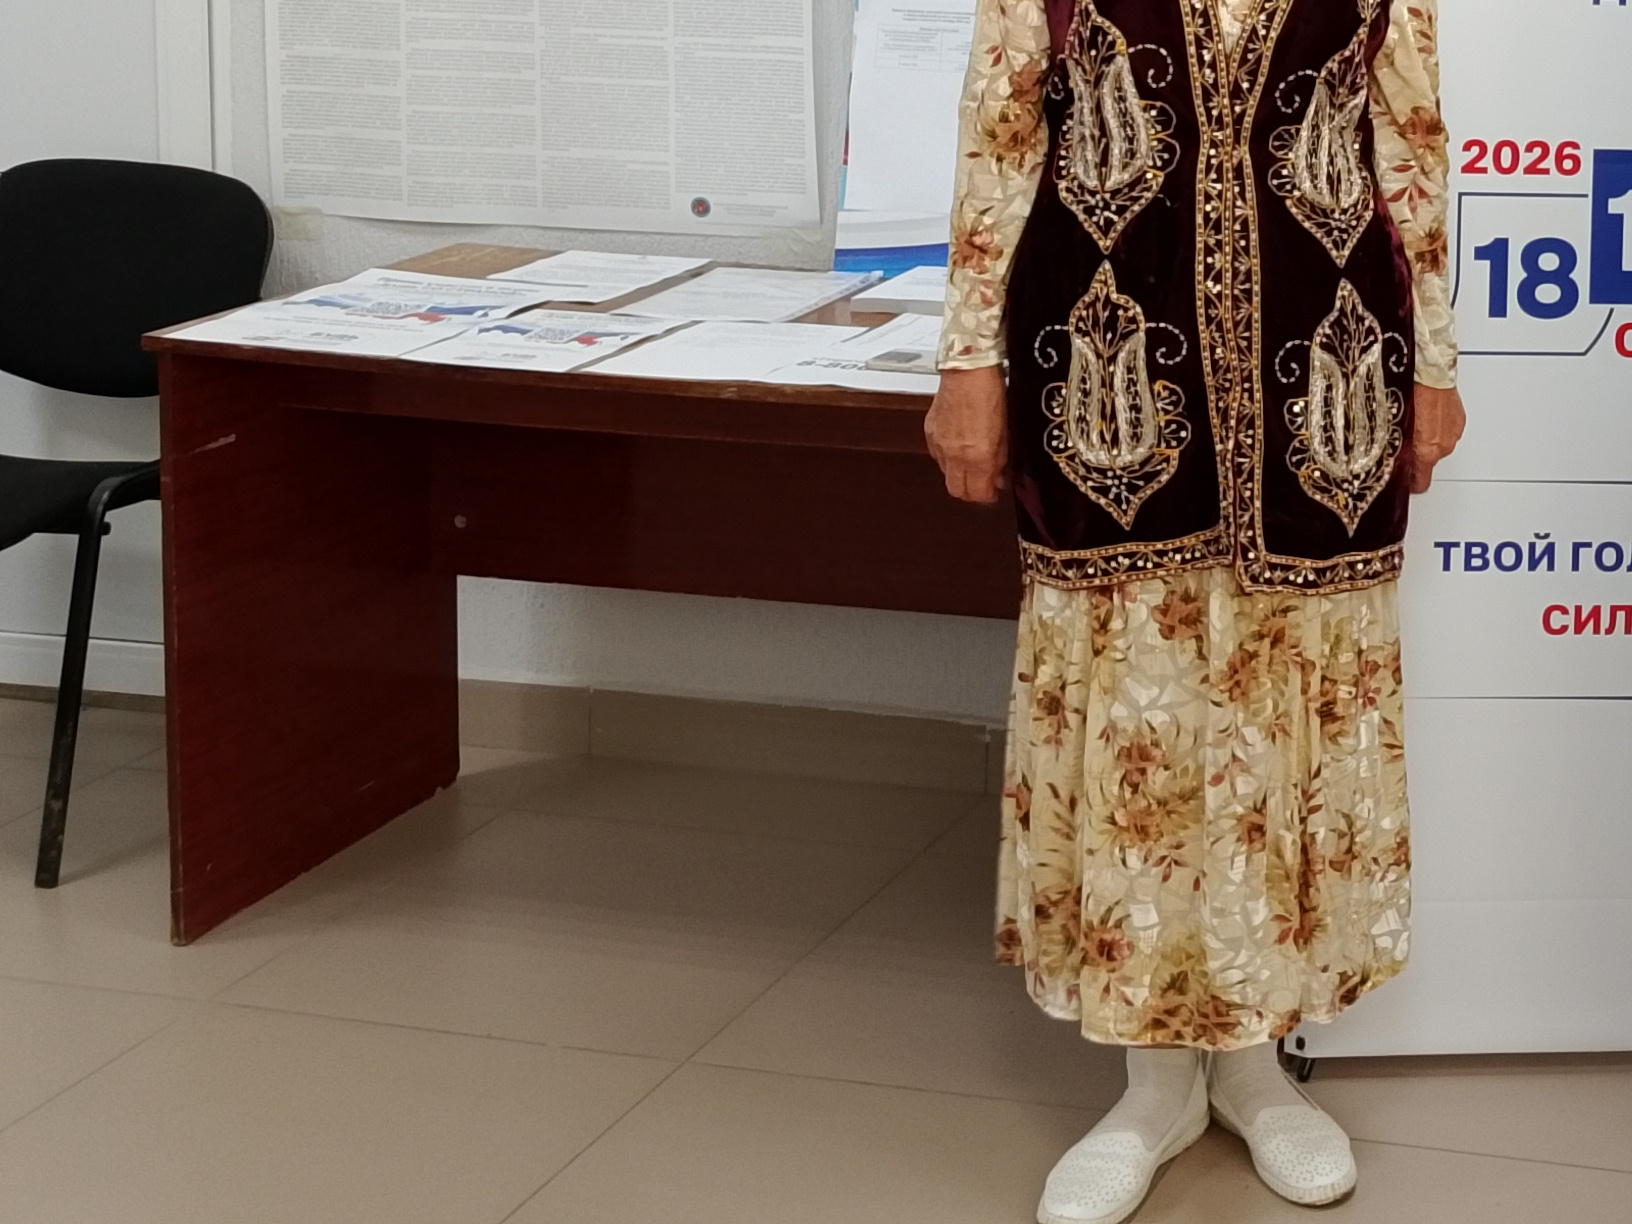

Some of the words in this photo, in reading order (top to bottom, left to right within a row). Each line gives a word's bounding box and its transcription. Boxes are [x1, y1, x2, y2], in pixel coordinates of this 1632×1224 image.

[1460, 139, 1582, 176] 2026
[1473, 236, 1580, 319] 18
[1433, 532, 1556, 573] ТВОЙ
